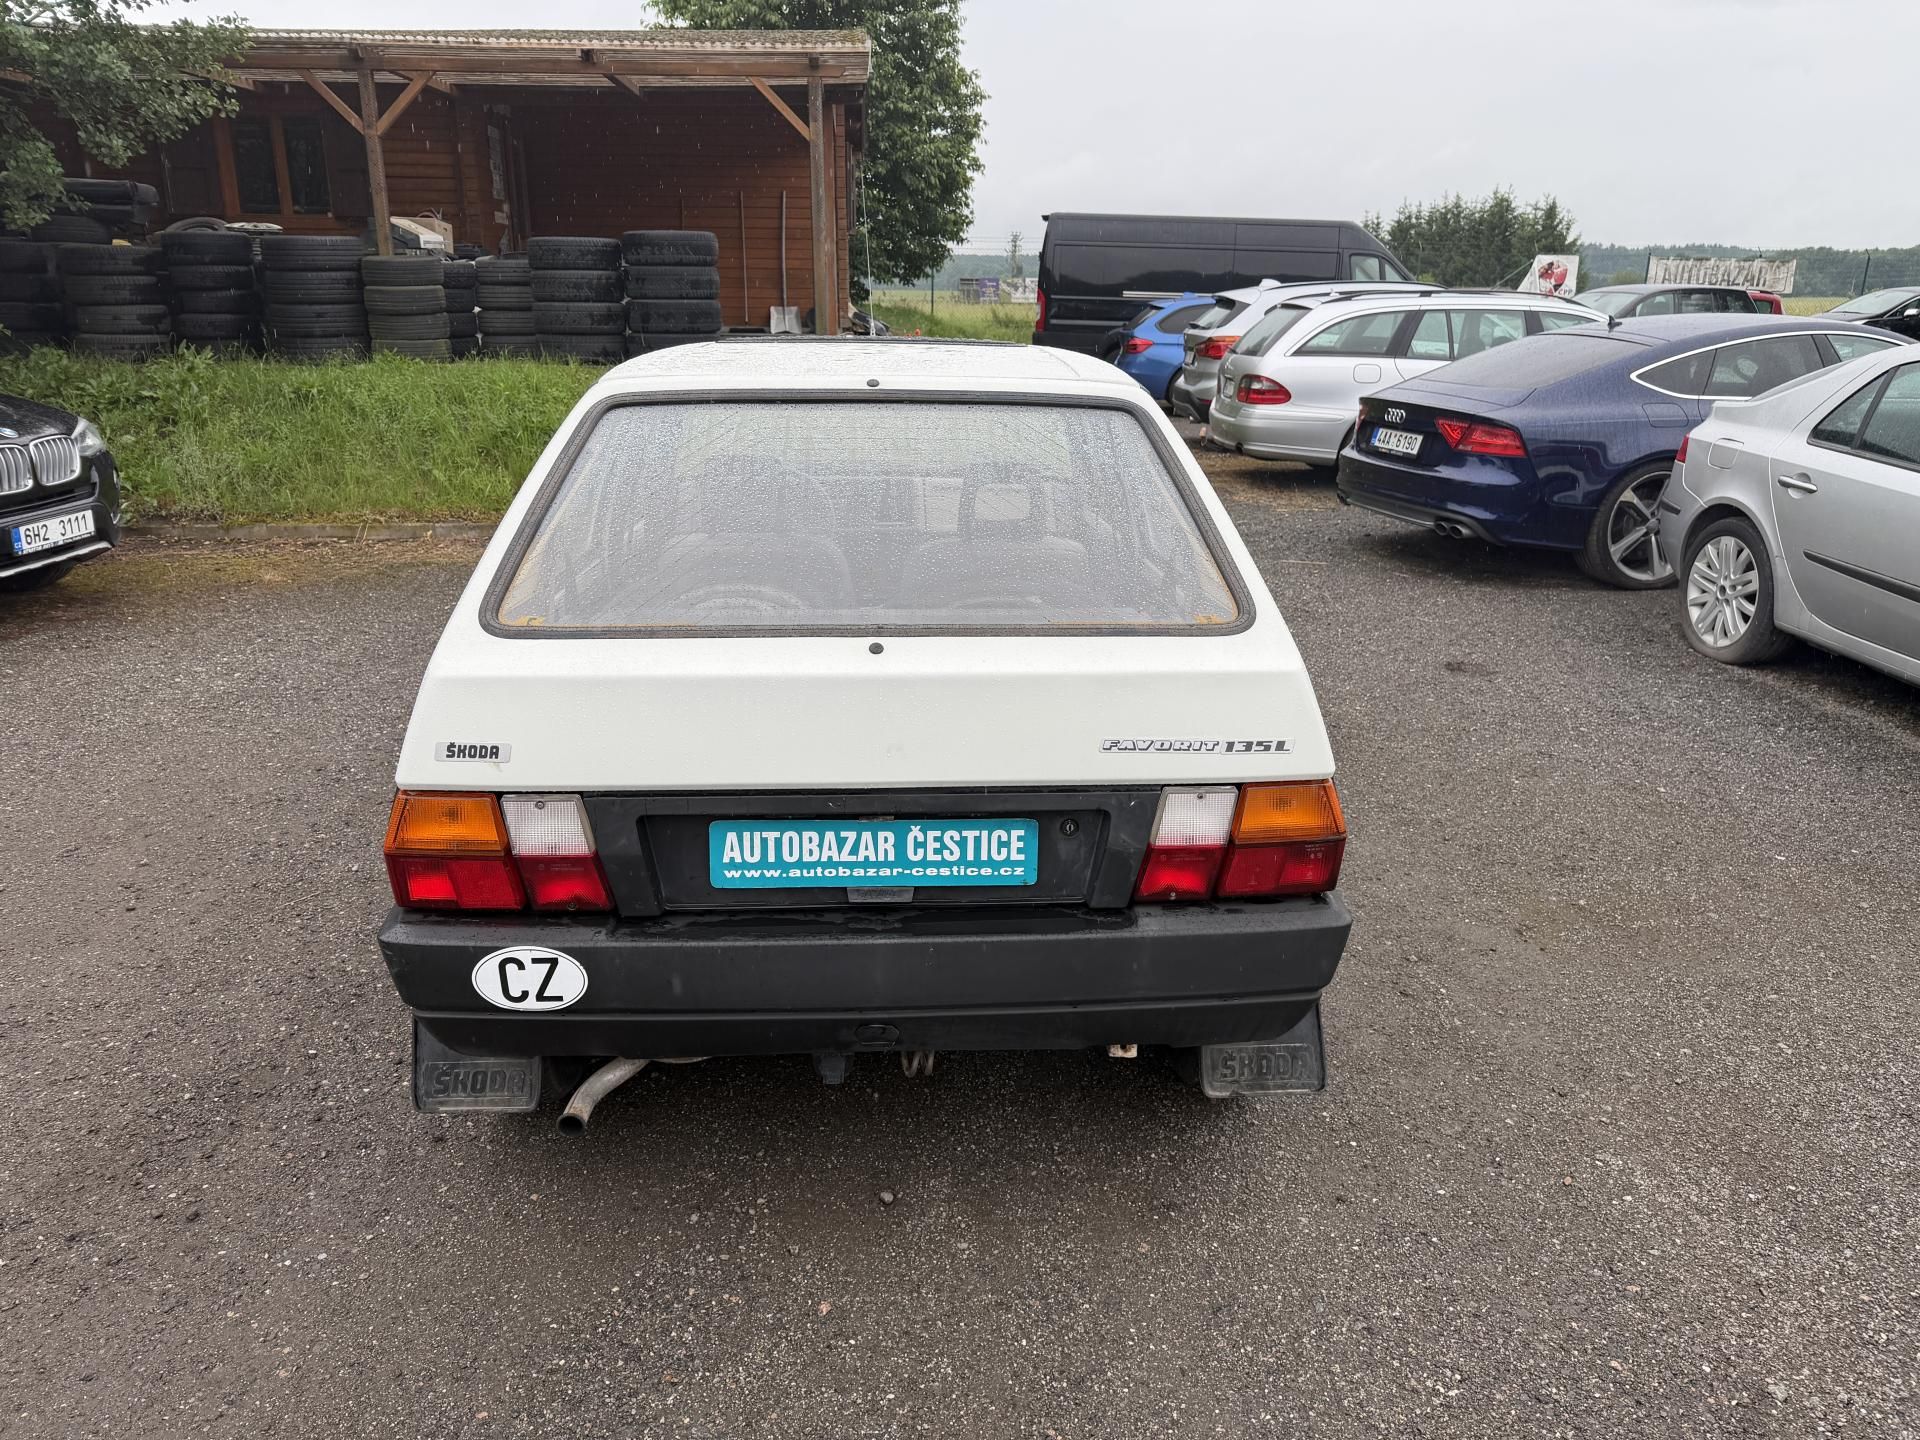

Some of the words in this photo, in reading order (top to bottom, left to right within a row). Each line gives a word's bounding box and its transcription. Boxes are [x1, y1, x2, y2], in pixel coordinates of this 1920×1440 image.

[1661, 259, 1768, 288] AUTOBAZAR
[1377, 430, 1392, 446] 4AA
[1396, 433, 1418, 451] 6190
[24, 524, 50, 545] 6H2
[59, 514, 88, 536] 3111
[445, 741, 500, 760] ŠKODA
[1102, 739, 1220, 752] FAVORIT
[1224, 740, 1292, 753] 135L
[722, 830, 895, 864] AUTOBAZAR
[906, 825, 1026, 862] ČESTICE
[723, 865, 1026, 878] www.autobazar-cestice.cz
[498, 956, 564, 1004] CZ
[432, 1064, 526, 1097] ŠKODA
